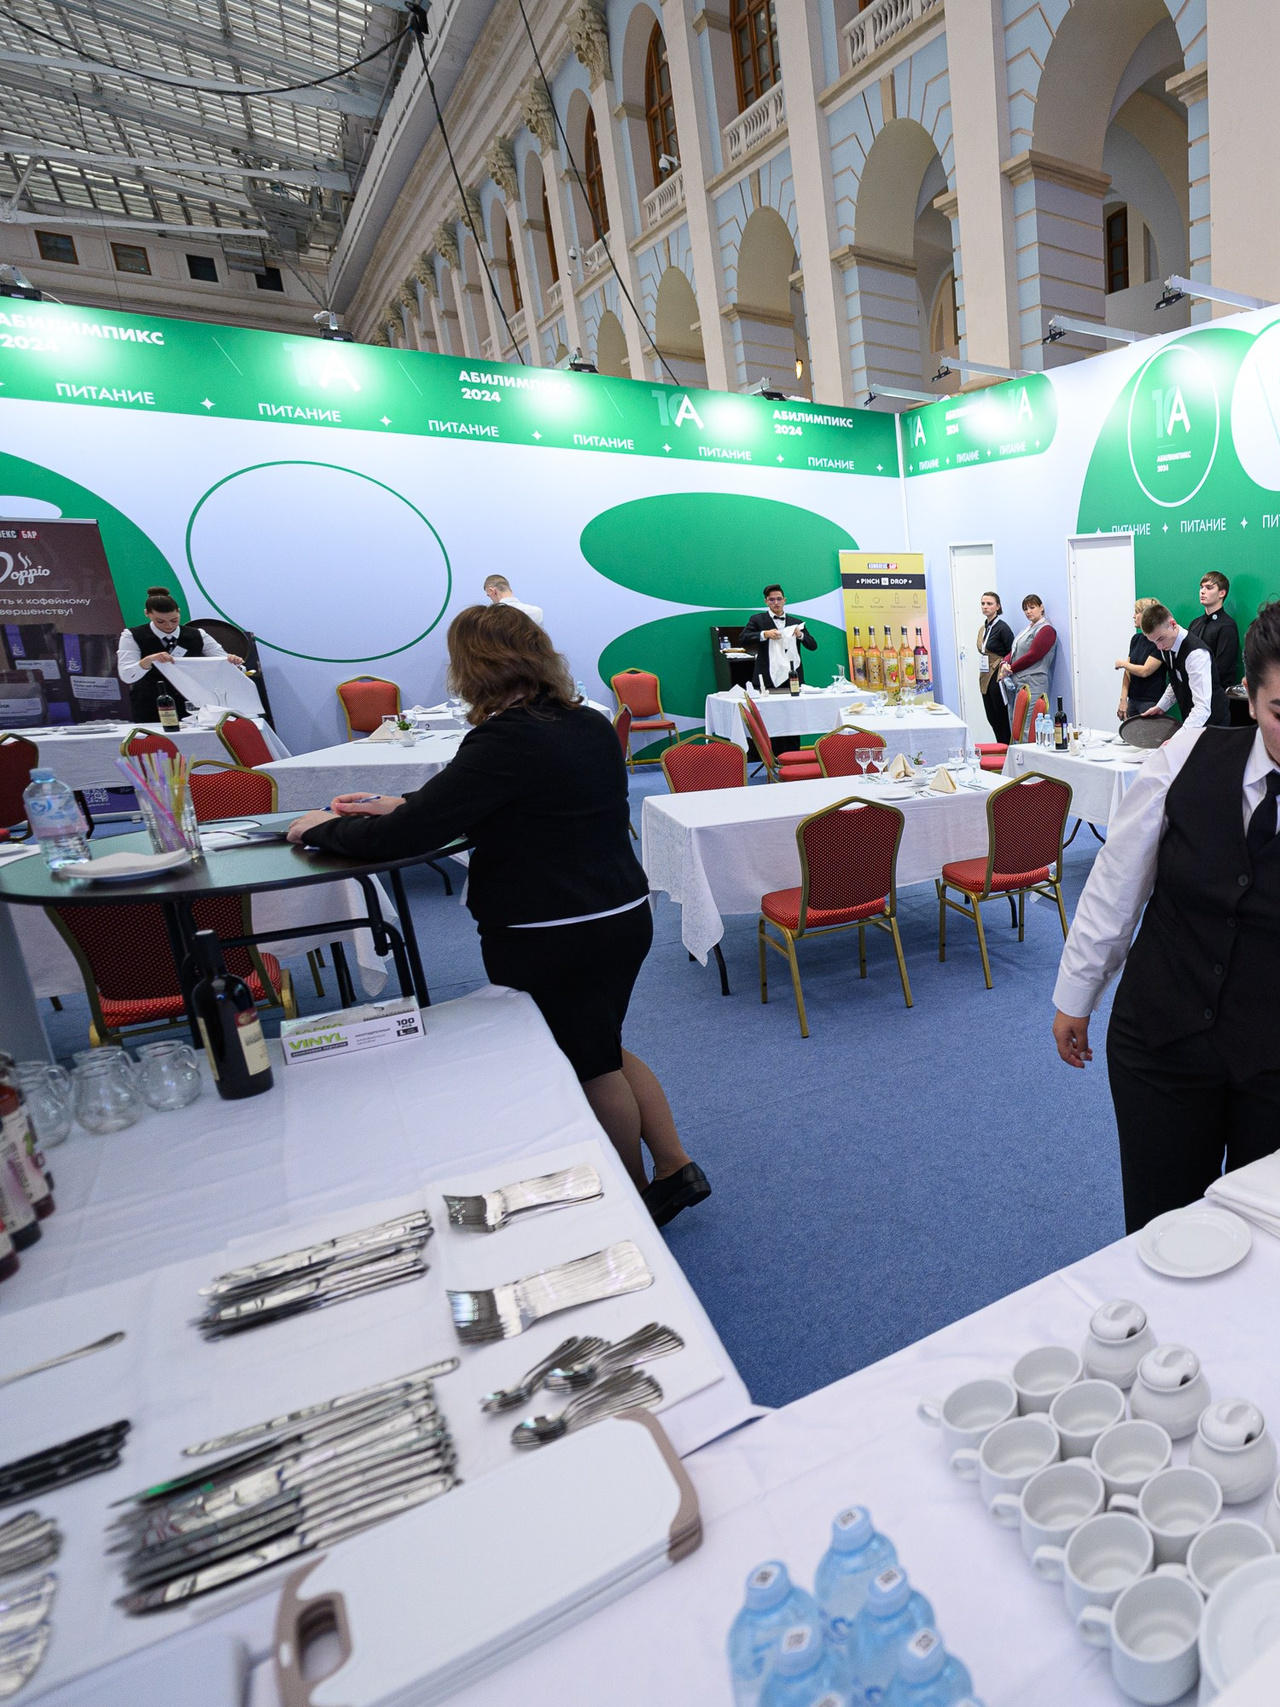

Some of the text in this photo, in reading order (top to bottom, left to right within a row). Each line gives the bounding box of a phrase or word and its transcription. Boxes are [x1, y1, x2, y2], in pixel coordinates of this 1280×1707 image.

[0, 333, 59, 352] 2024
[459, 370, 572, 395] АБИЛИМПС
[461, 388, 501, 403] 2024
[56, 382, 855, 470] ПИТАНИЕ ПИТАНИЕ ПИТАНИЕ ПИТАНИЕ ПИТАНИЕ ПИТАНИЕ
[773, 409, 853, 428] АБИЛИМПИКС
[775, 425, 803, 437] 2024
[21, 530, 37, 539] БАР
[1111, 523, 1151, 536] ПИТАНИЕ
[1180, 517, 1227, 533] ПИТАНИЕ
[26, 597, 91, 606] кофейному
[396, 1017, 415, 1027] 100
[288, 1032, 348, 1050] VINYL
